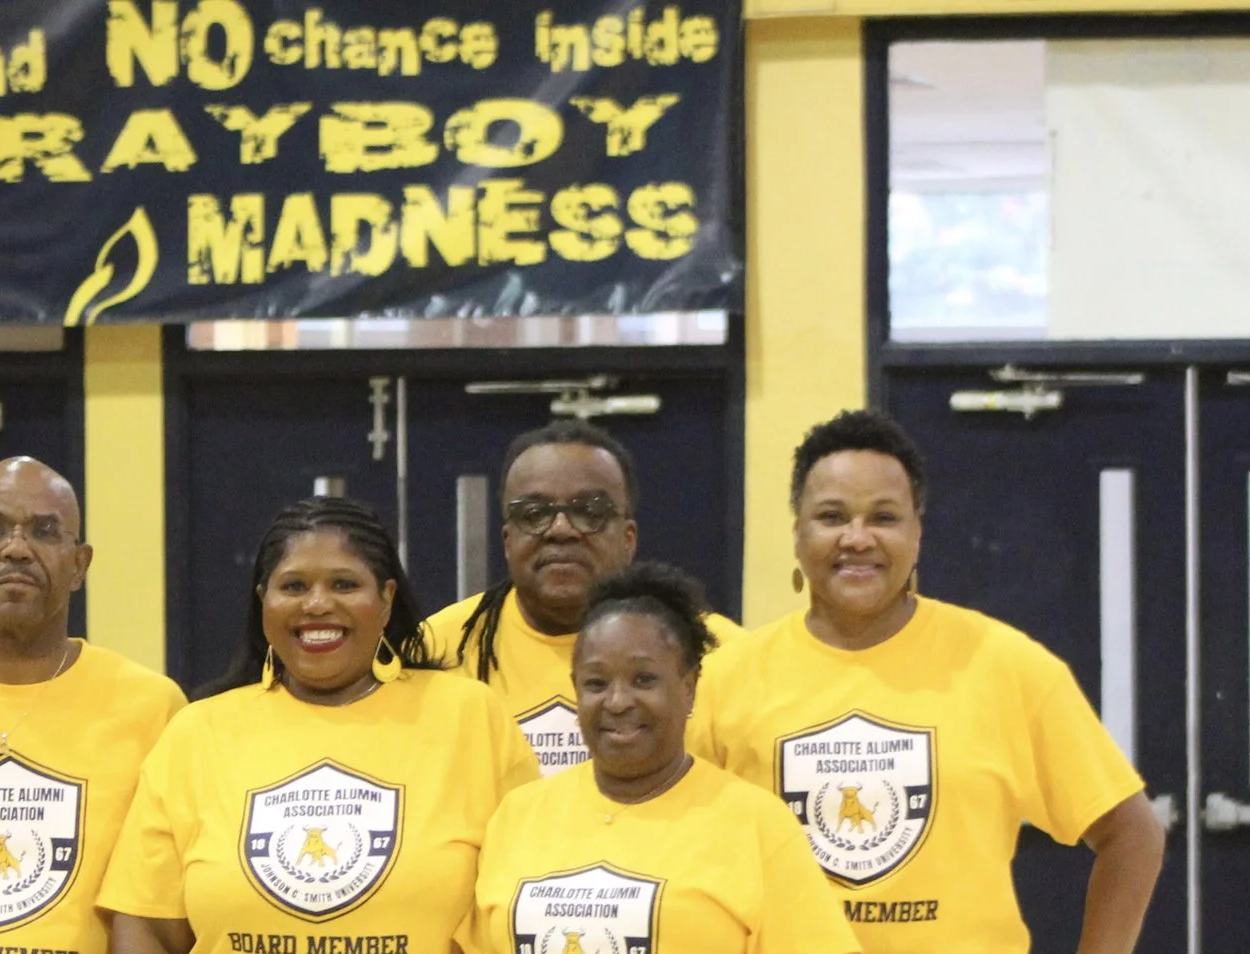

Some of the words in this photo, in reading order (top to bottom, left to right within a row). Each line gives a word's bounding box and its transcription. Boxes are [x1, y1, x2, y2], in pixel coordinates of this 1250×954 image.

[105, 0, 254, 91] NO
[265, 8, 498, 77] chance
[536, 6, 719, 74] inside
[187, 178, 697, 286] MADNESS
[794, 741, 861, 756] CHARLOTTE
[866, 738, 914, 755] ALUMNI
[816, 758, 895, 773] ASSOCIATION
[18, 788, 64, 802] ALUMNI
[264, 789, 330, 806] CHARLOTTE
[334, 788, 382, 803] ALUMNI
[909, 794, 927, 808] 67
[283, 804, 362, 818] ASSOCIATION
[251, 839, 265, 850] 18
[373, 837, 390, 849] 67
[55, 847, 72, 861] 67
[529, 886, 593, 900] CHARLOTTE
[596, 886, 641, 900] ALUMNI
[544, 903, 619, 918] ASSOCIATION
[844, 900, 939, 923] MEMBER
